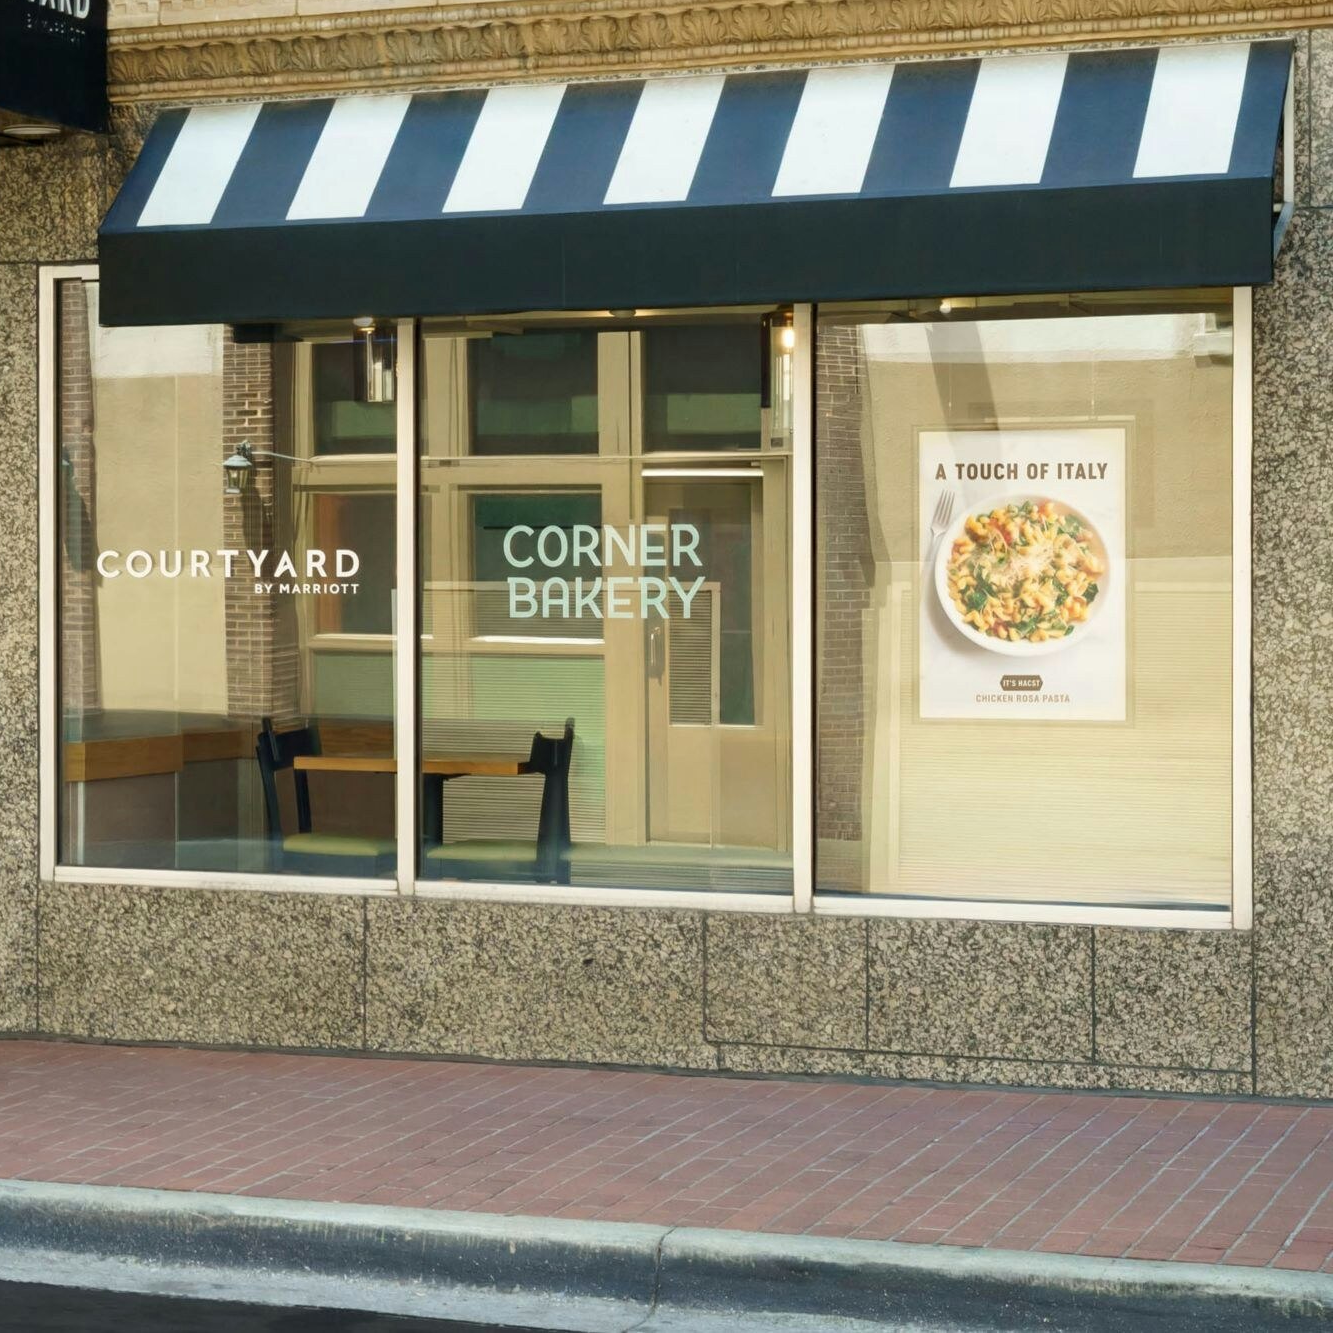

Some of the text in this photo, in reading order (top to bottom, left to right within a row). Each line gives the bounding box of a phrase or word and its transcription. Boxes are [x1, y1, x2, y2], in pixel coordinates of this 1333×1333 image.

[935, 462, 1108, 480] A TOUCH OF ITALY
[502, 524, 703, 568] CORNER
[96, 549, 361, 579] COURTYARD
[254, 583, 360, 595] BY MARRIOTT
[507, 576, 706, 619] BAKERY
[975, 694, 1014, 703] CHICKEN
[1042, 694, 1070, 703] PASTA
